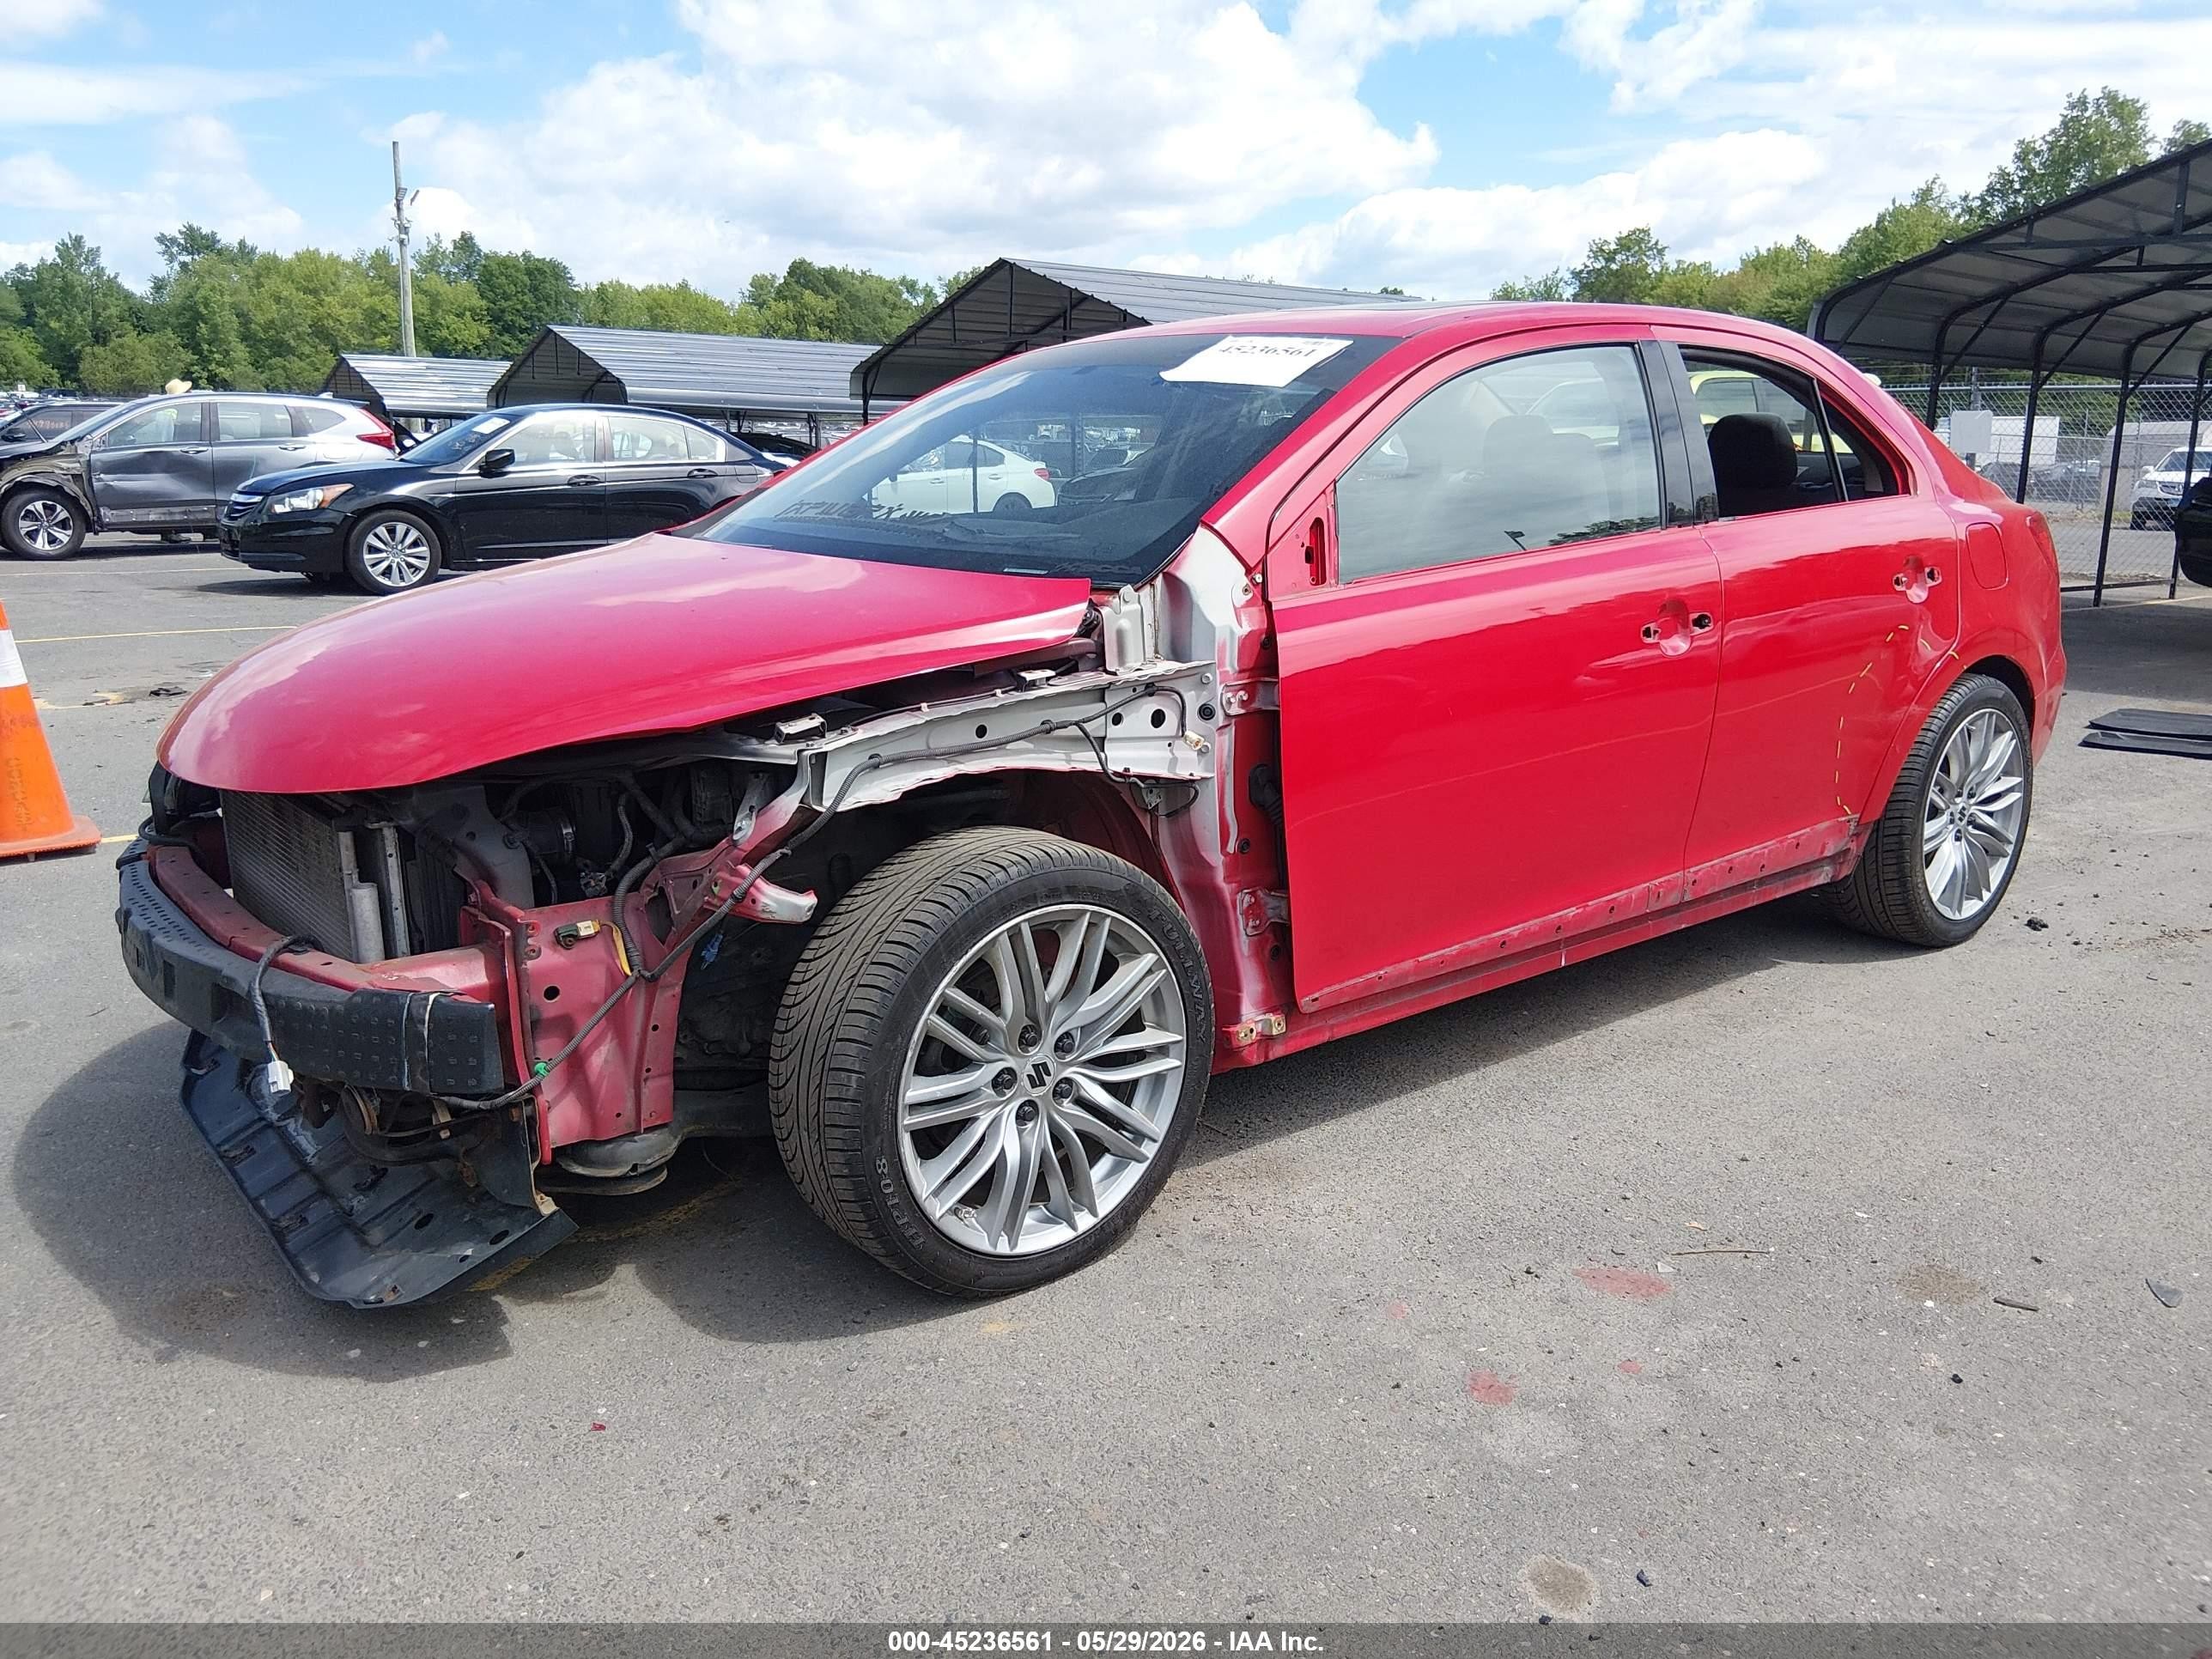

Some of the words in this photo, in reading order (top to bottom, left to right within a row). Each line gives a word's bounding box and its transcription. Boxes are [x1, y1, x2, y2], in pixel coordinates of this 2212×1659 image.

[1218, 345, 1318, 357] 45236561
[1148, 907, 1206, 1043] FULLWAY
[875, 1156, 927, 1250] HP108
